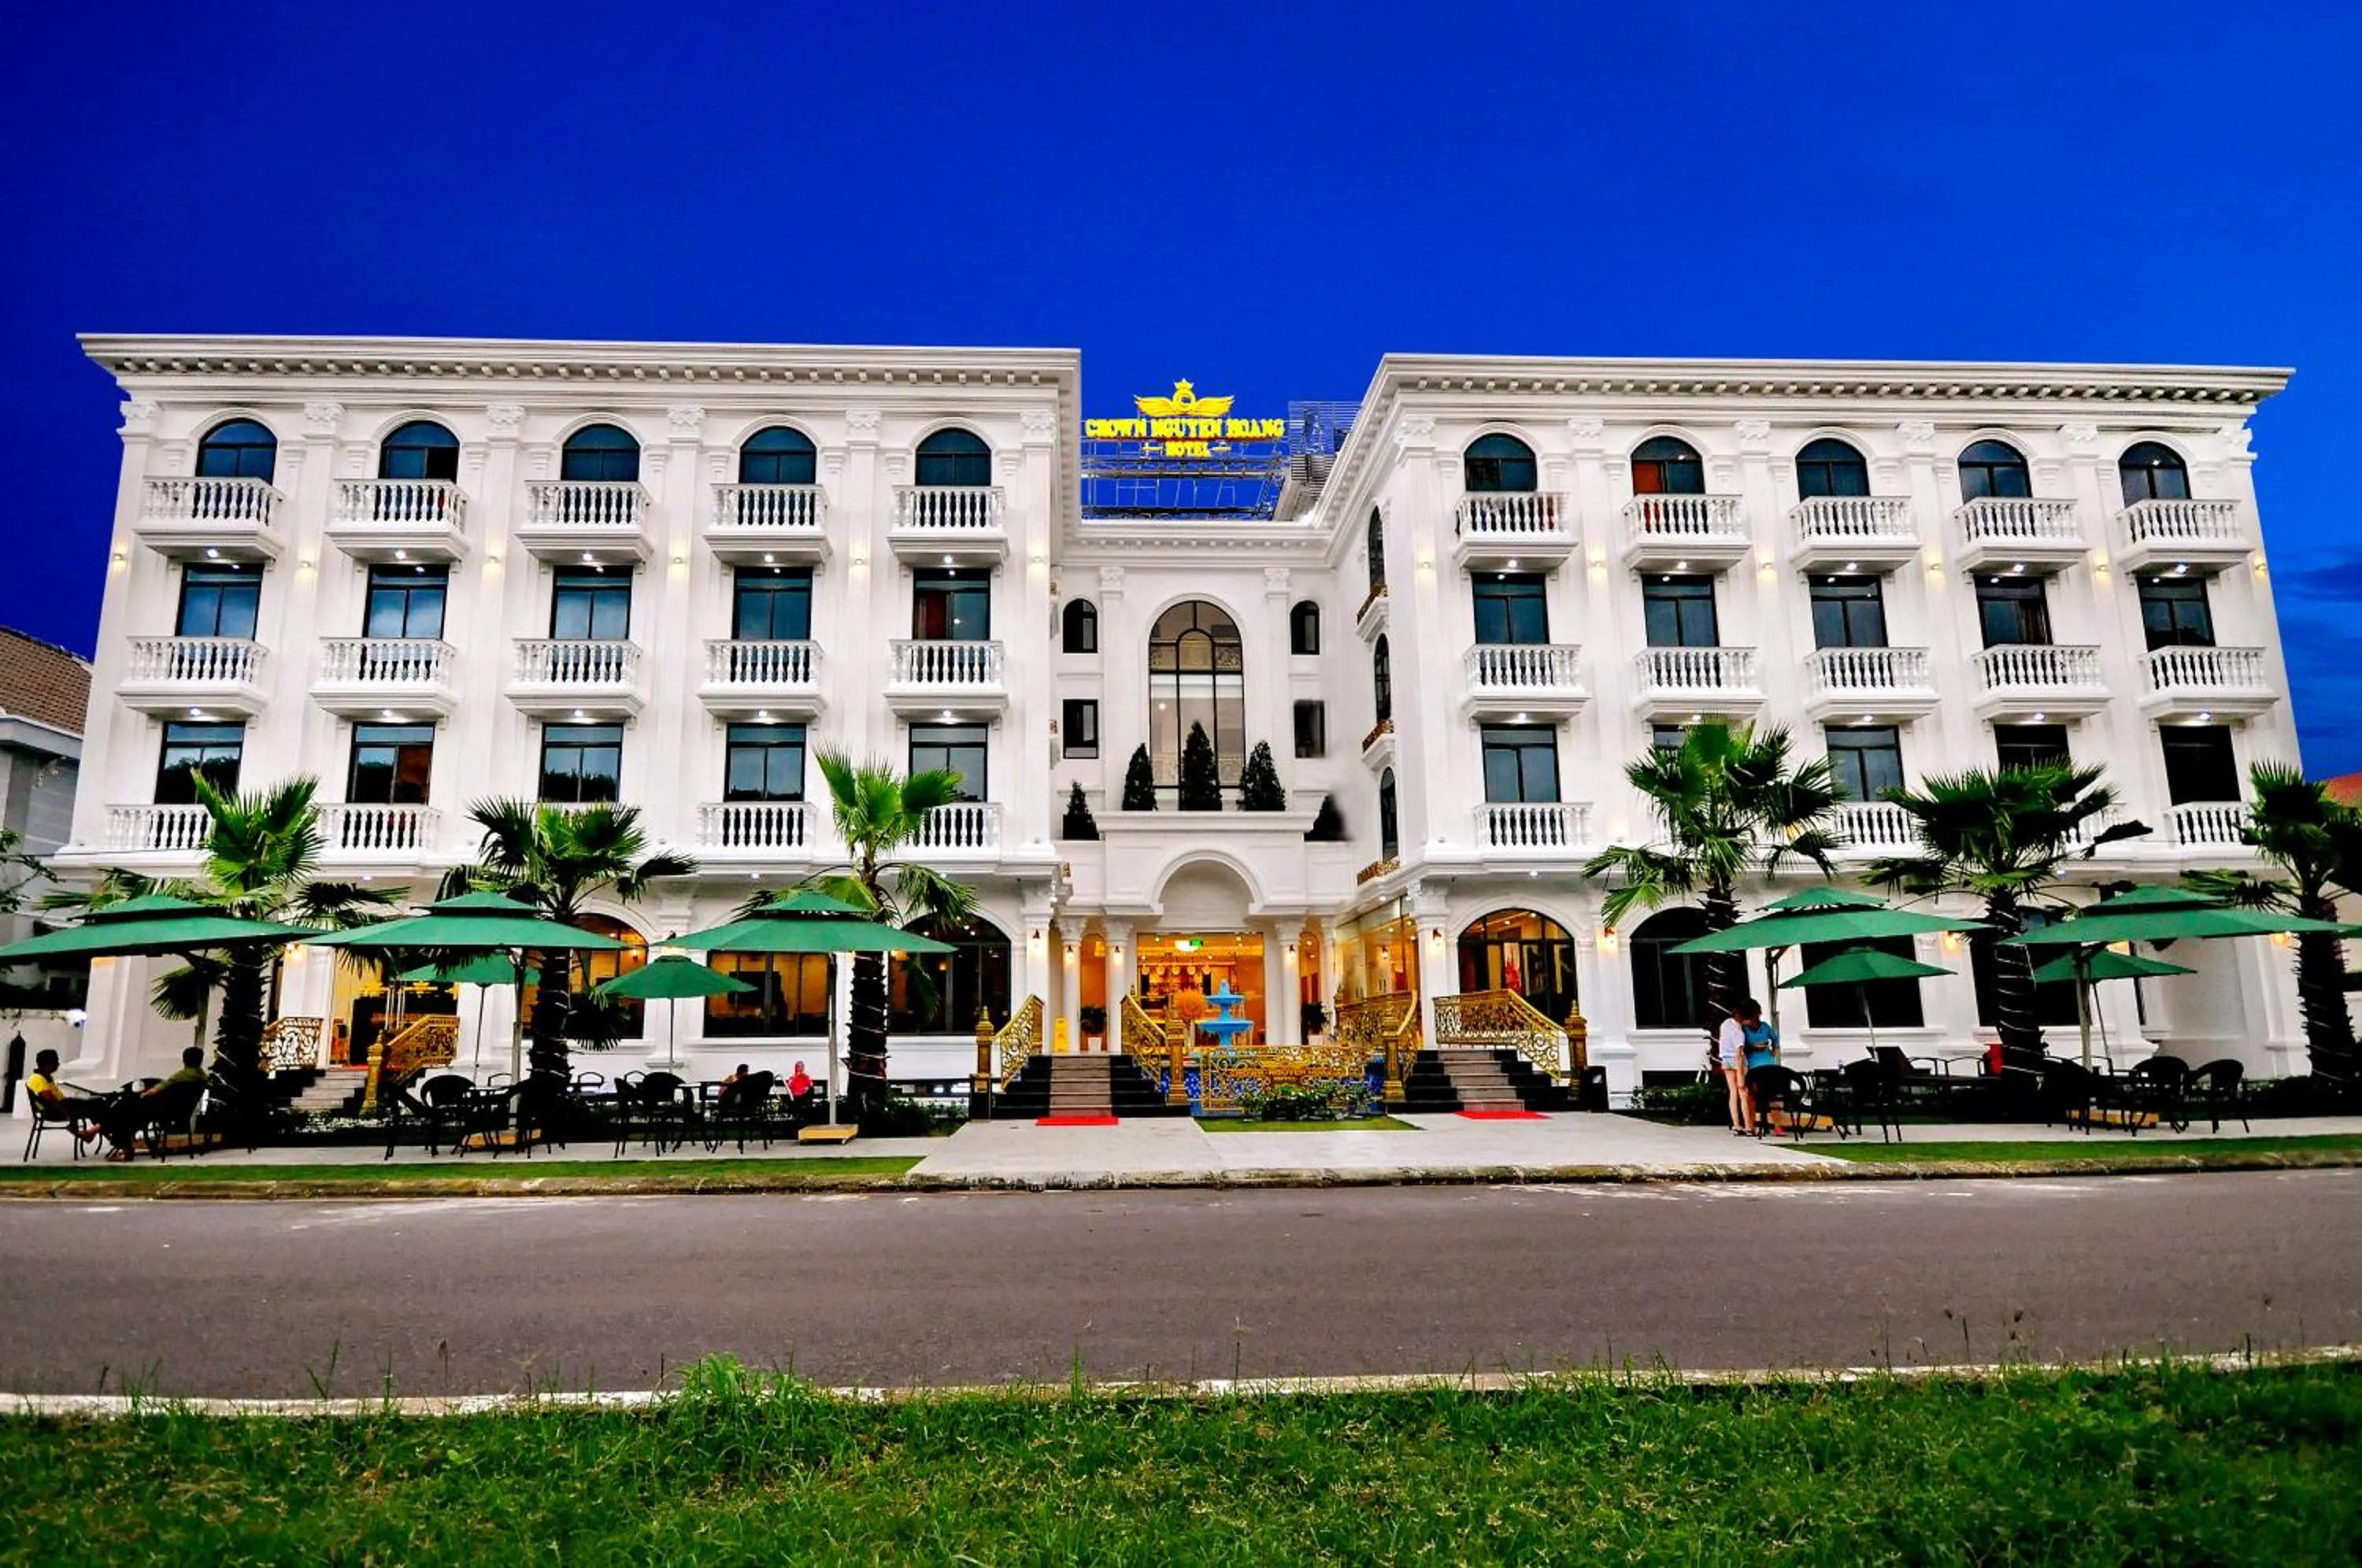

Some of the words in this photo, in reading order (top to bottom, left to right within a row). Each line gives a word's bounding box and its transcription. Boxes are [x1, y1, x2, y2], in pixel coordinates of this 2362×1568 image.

[1084, 418, 1147, 438] CROWN
[1150, 417, 1222, 438] NGUYEN
[1226, 418, 1284, 438] HOANG
[1164, 440, 1210, 457] HOTEL
